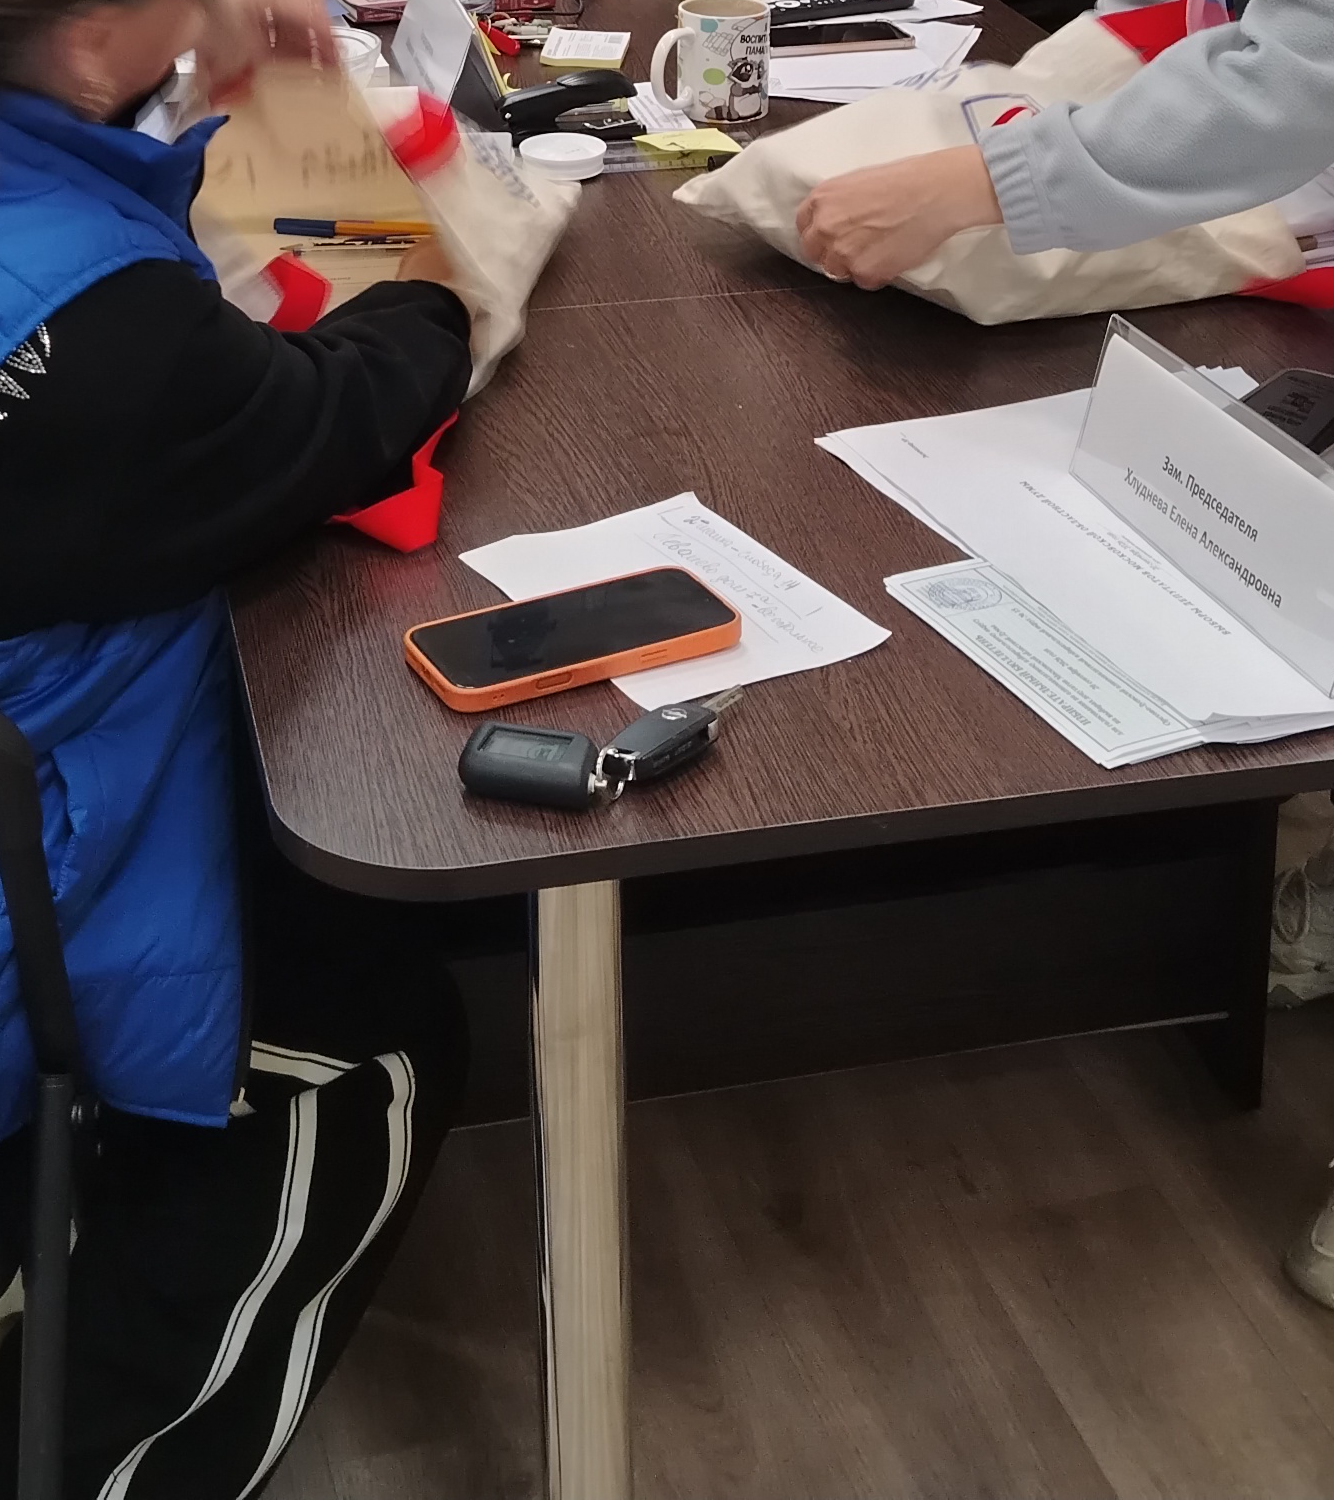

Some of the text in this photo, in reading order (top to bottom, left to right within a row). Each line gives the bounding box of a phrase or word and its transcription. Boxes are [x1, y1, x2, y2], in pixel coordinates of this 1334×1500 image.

[740, 34, 768, 44] ВОСПИТ
[1162, 455, 1259, 543] Зам. Председателя
[1087, 530, 1144, 573] МОСКОВСКОЙ
[1123, 467, 1283, 609] Хлуднева Елена Александровна
[1141, 569, 1194, 608] ДЕПУТАТОВ
[1191, 605, 1231, 636] ВЫБОРЫ
